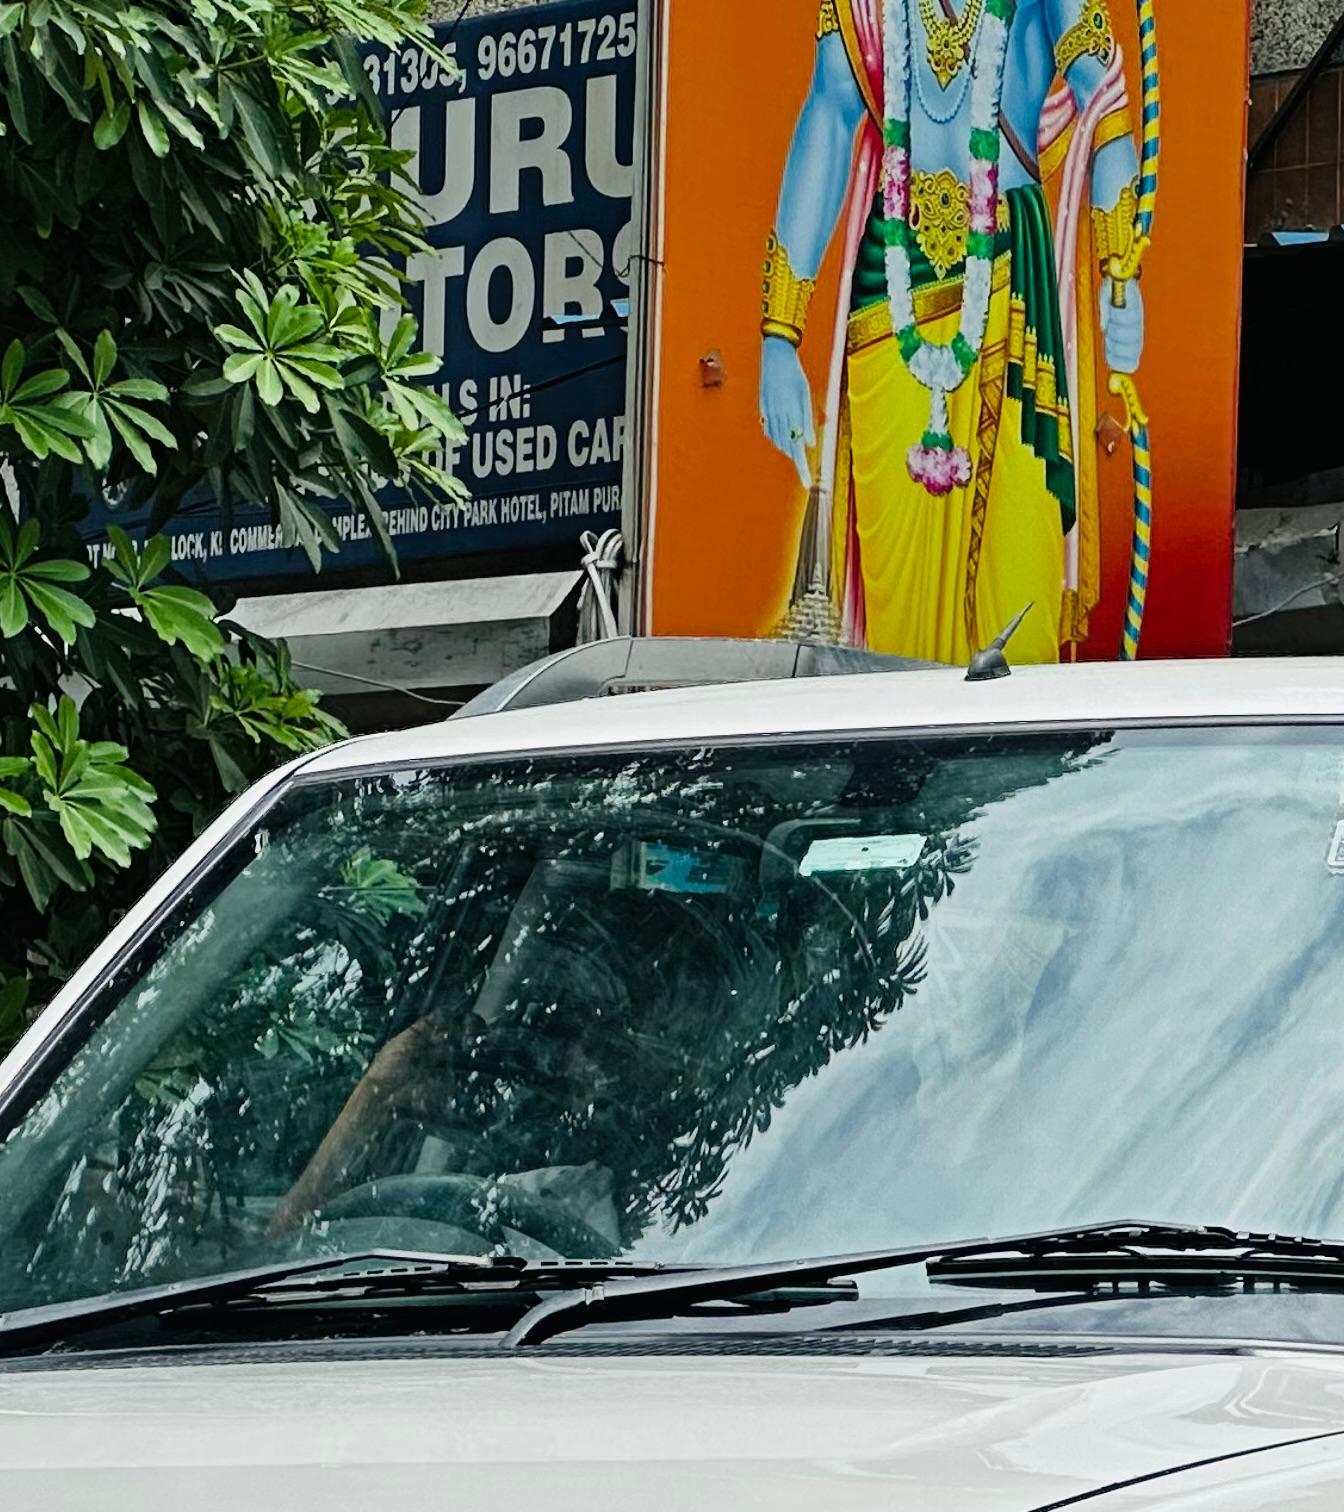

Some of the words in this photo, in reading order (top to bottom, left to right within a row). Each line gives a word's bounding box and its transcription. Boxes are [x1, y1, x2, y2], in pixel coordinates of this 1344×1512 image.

[356, 74, 633, 228] URU
[471, 424, 558, 480] USED
[462, 495, 499, 530] PARK
[501, 493, 548, 525] HOTEL,
[549, 486, 591, 520] PITAM
